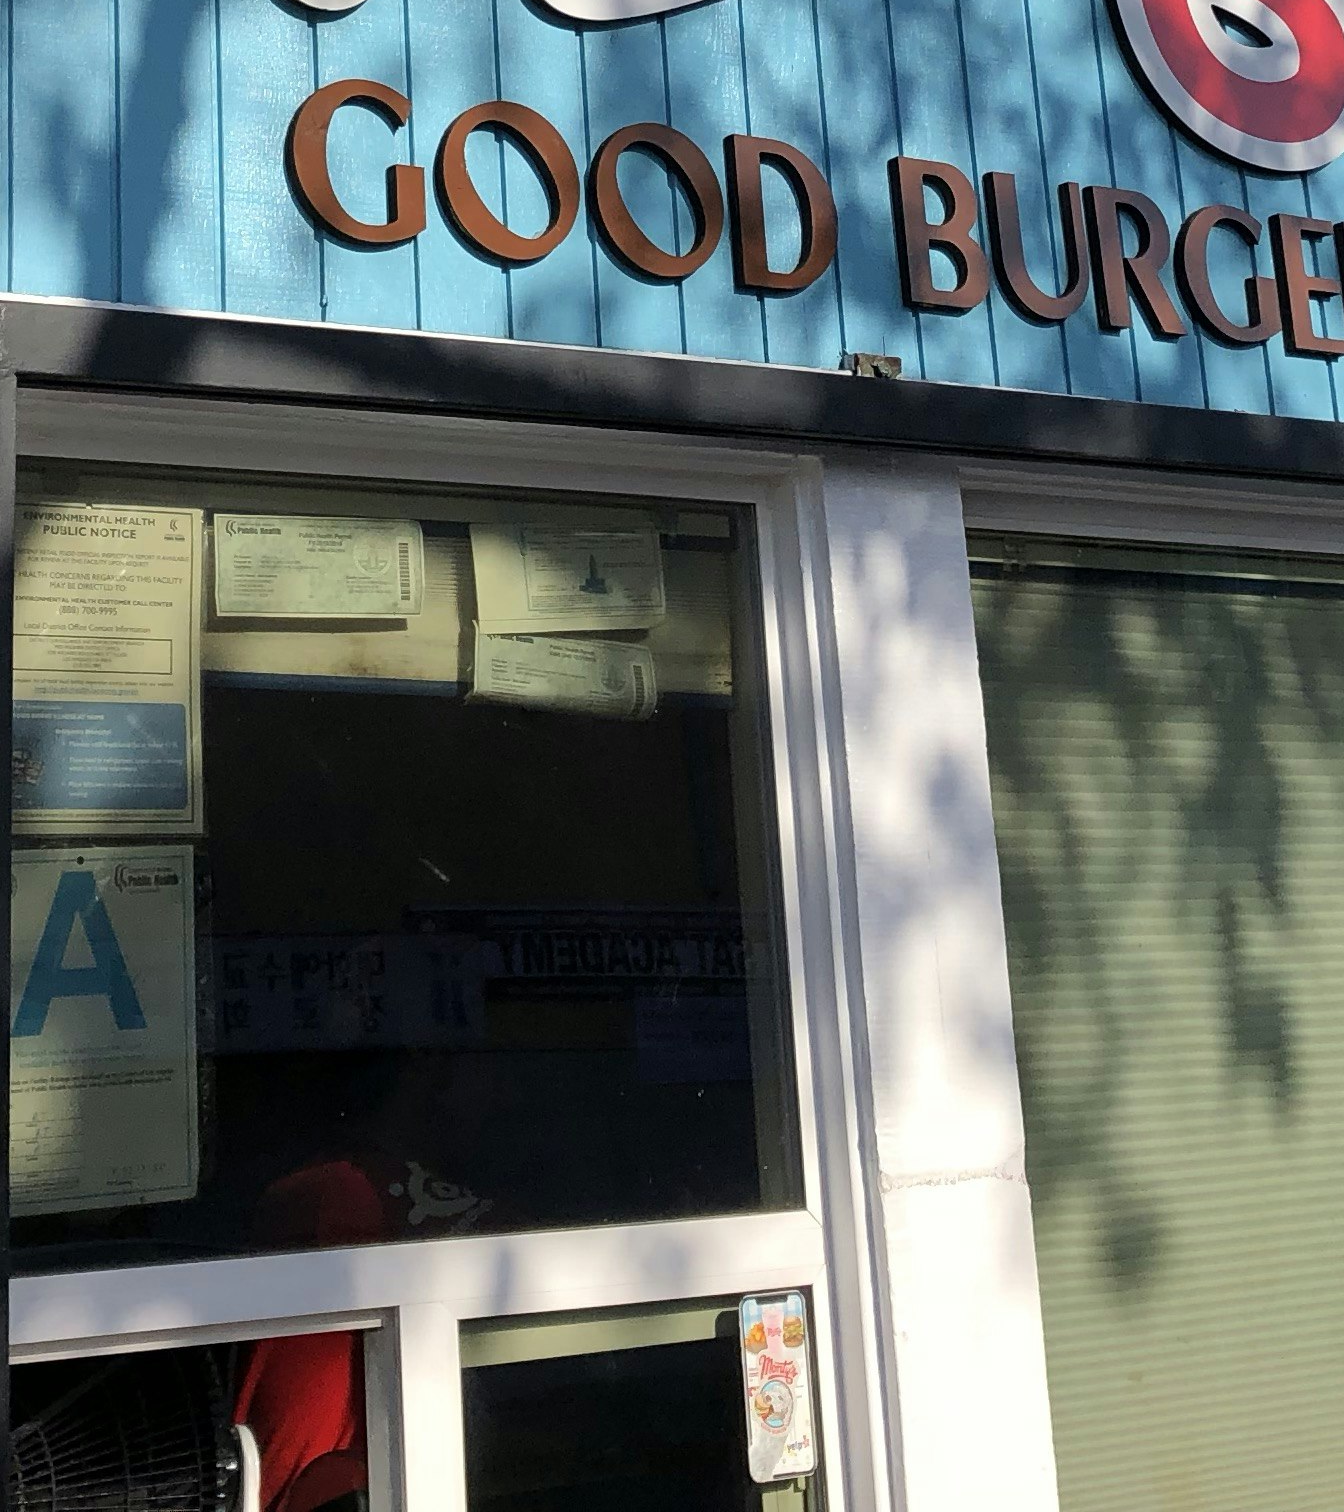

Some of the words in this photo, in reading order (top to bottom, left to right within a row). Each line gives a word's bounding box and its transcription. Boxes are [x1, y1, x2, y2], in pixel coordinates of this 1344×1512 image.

[286, 78, 837, 294] GOOD
[22, 511, 113, 525] ENVIRONMENTAL
[114, 516, 156, 527] HEALTH
[43, 524, 87, 536] PUBLIC
[90, 527, 137, 539] NOTICE
[49, 572, 91, 580] CONCERNS
[153, 576, 183, 584] FACILITY
[49, 581, 66, 590] MAY
[77, 583, 113, 591] DIRECTED
[10, 870, 148, 1039] A
